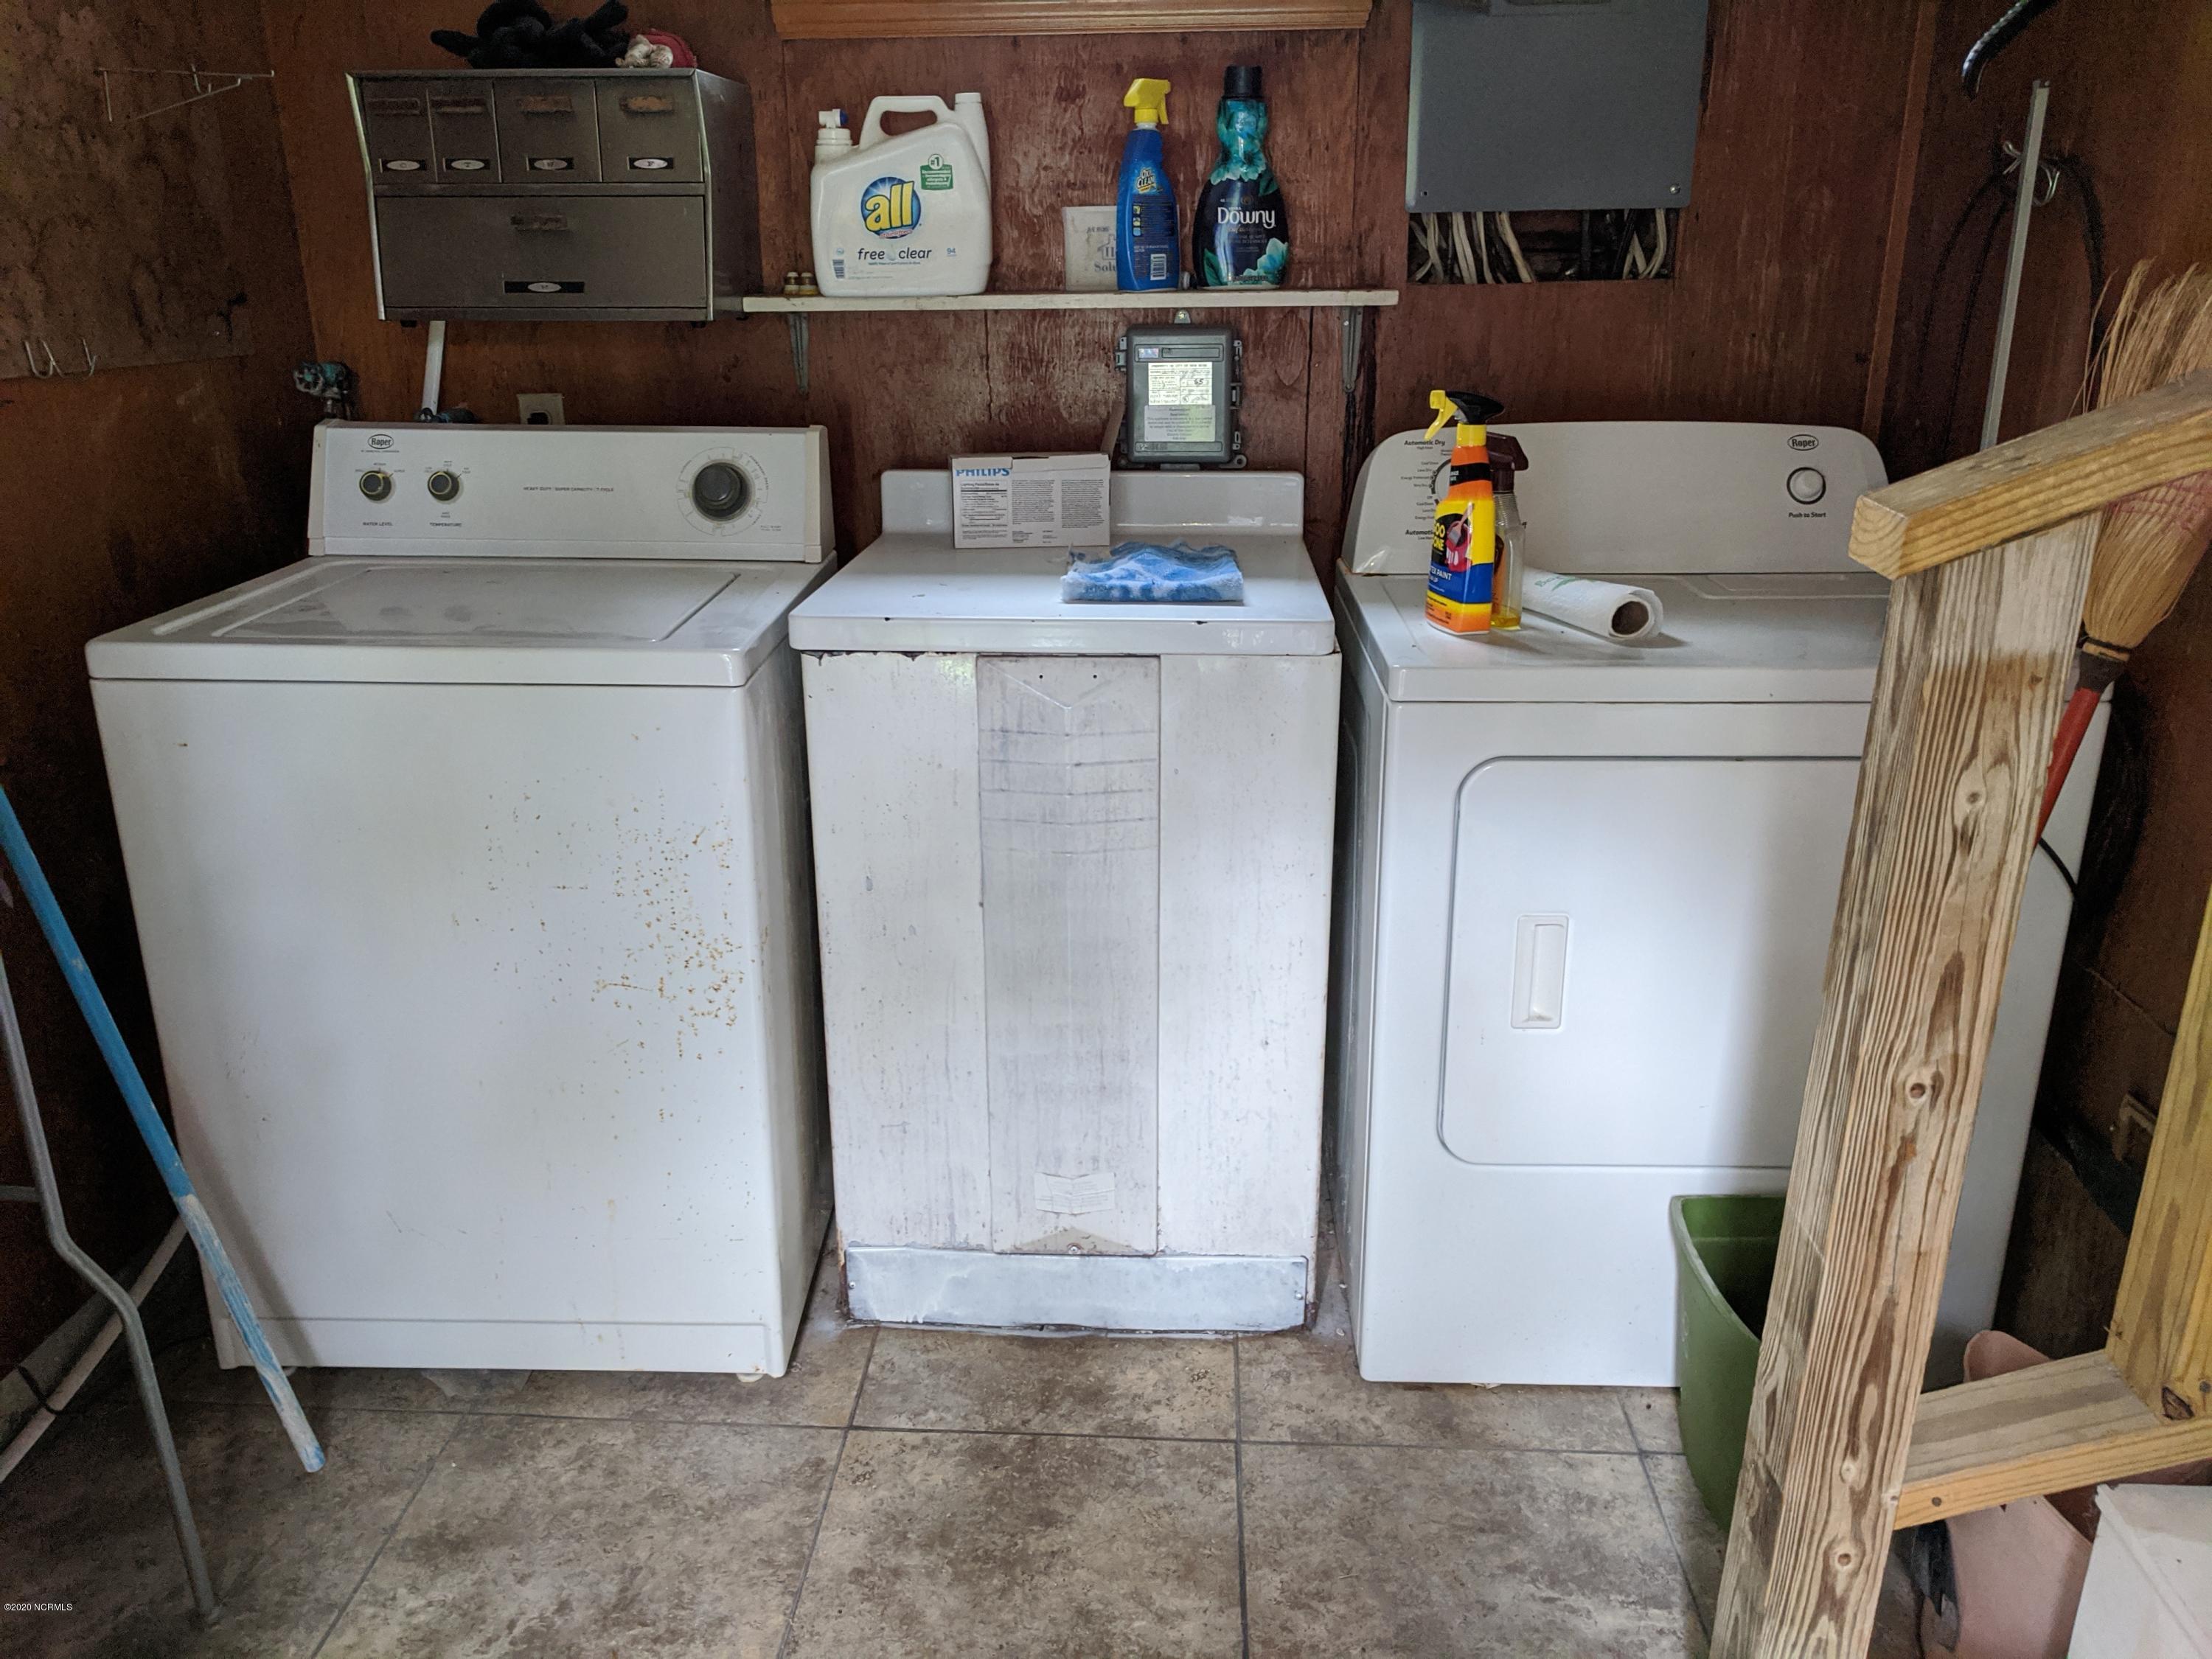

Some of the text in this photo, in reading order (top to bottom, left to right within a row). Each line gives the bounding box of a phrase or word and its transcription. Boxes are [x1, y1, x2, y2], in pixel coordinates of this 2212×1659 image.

[931, 156, 940, 167] #1
[864, 181, 914, 232] all
[1217, 206, 1276, 229] Downy
[858, 247, 932, 260] free clear
[371, 438, 392, 447] Roper
[1792, 439, 1815, 448] Roper
[956, 468, 1009, 476] PHILIPS
[1434, 521, 1446, 538] OO
[1433, 537, 1444, 551] ONE
[1436, 571, 1452, 581] PAINT
